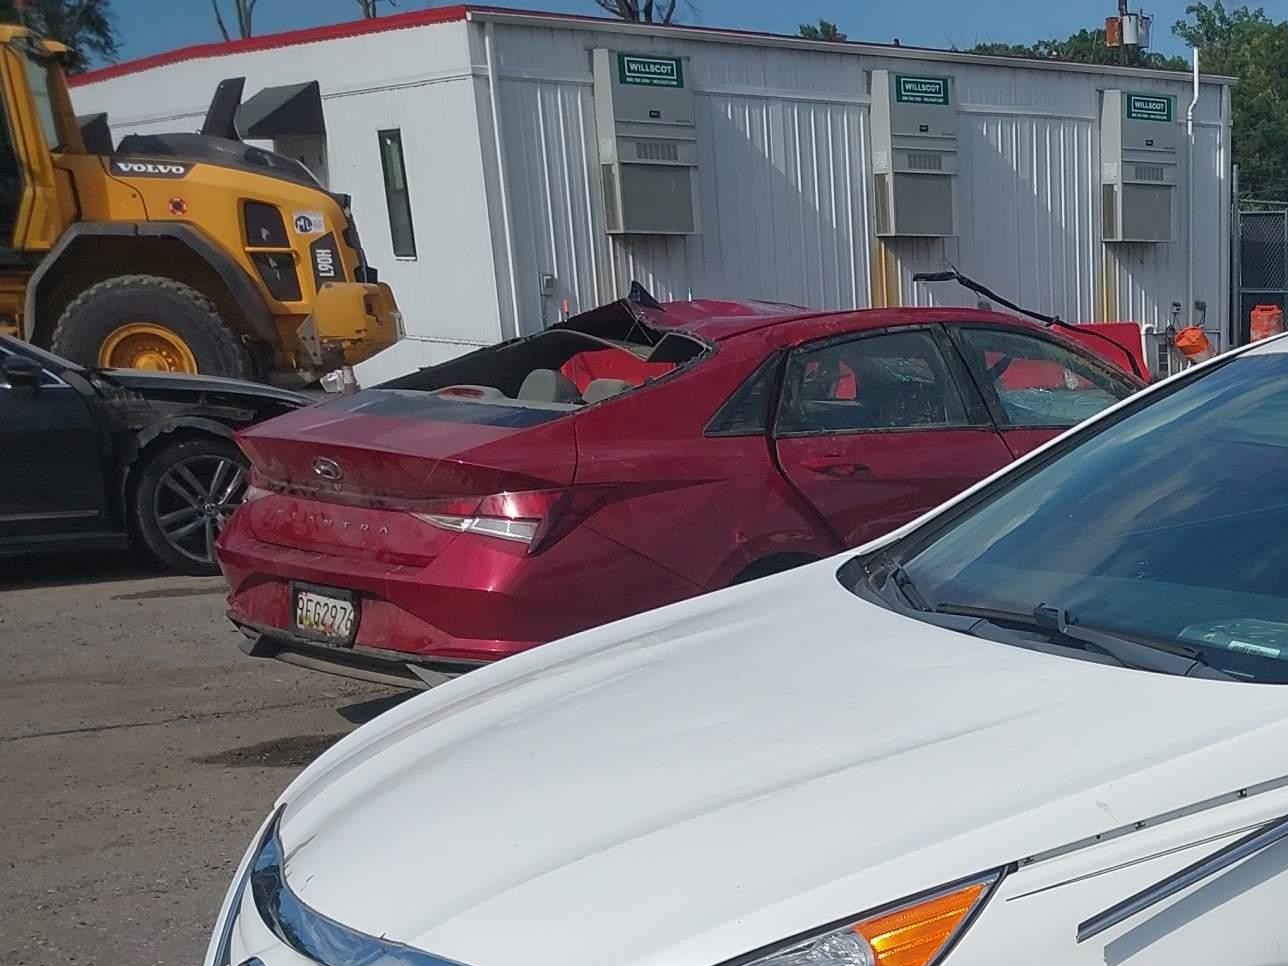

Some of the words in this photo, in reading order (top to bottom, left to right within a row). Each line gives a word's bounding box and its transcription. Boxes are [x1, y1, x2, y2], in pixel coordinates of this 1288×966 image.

[629, 62, 672, 74] WILLSCOT
[904, 83, 940, 93] WILLSCOT
[1134, 101, 1165, 110] WILLSCOT
[117, 162, 185, 174] VOLVO
[315, 249, 335, 277] L90H
